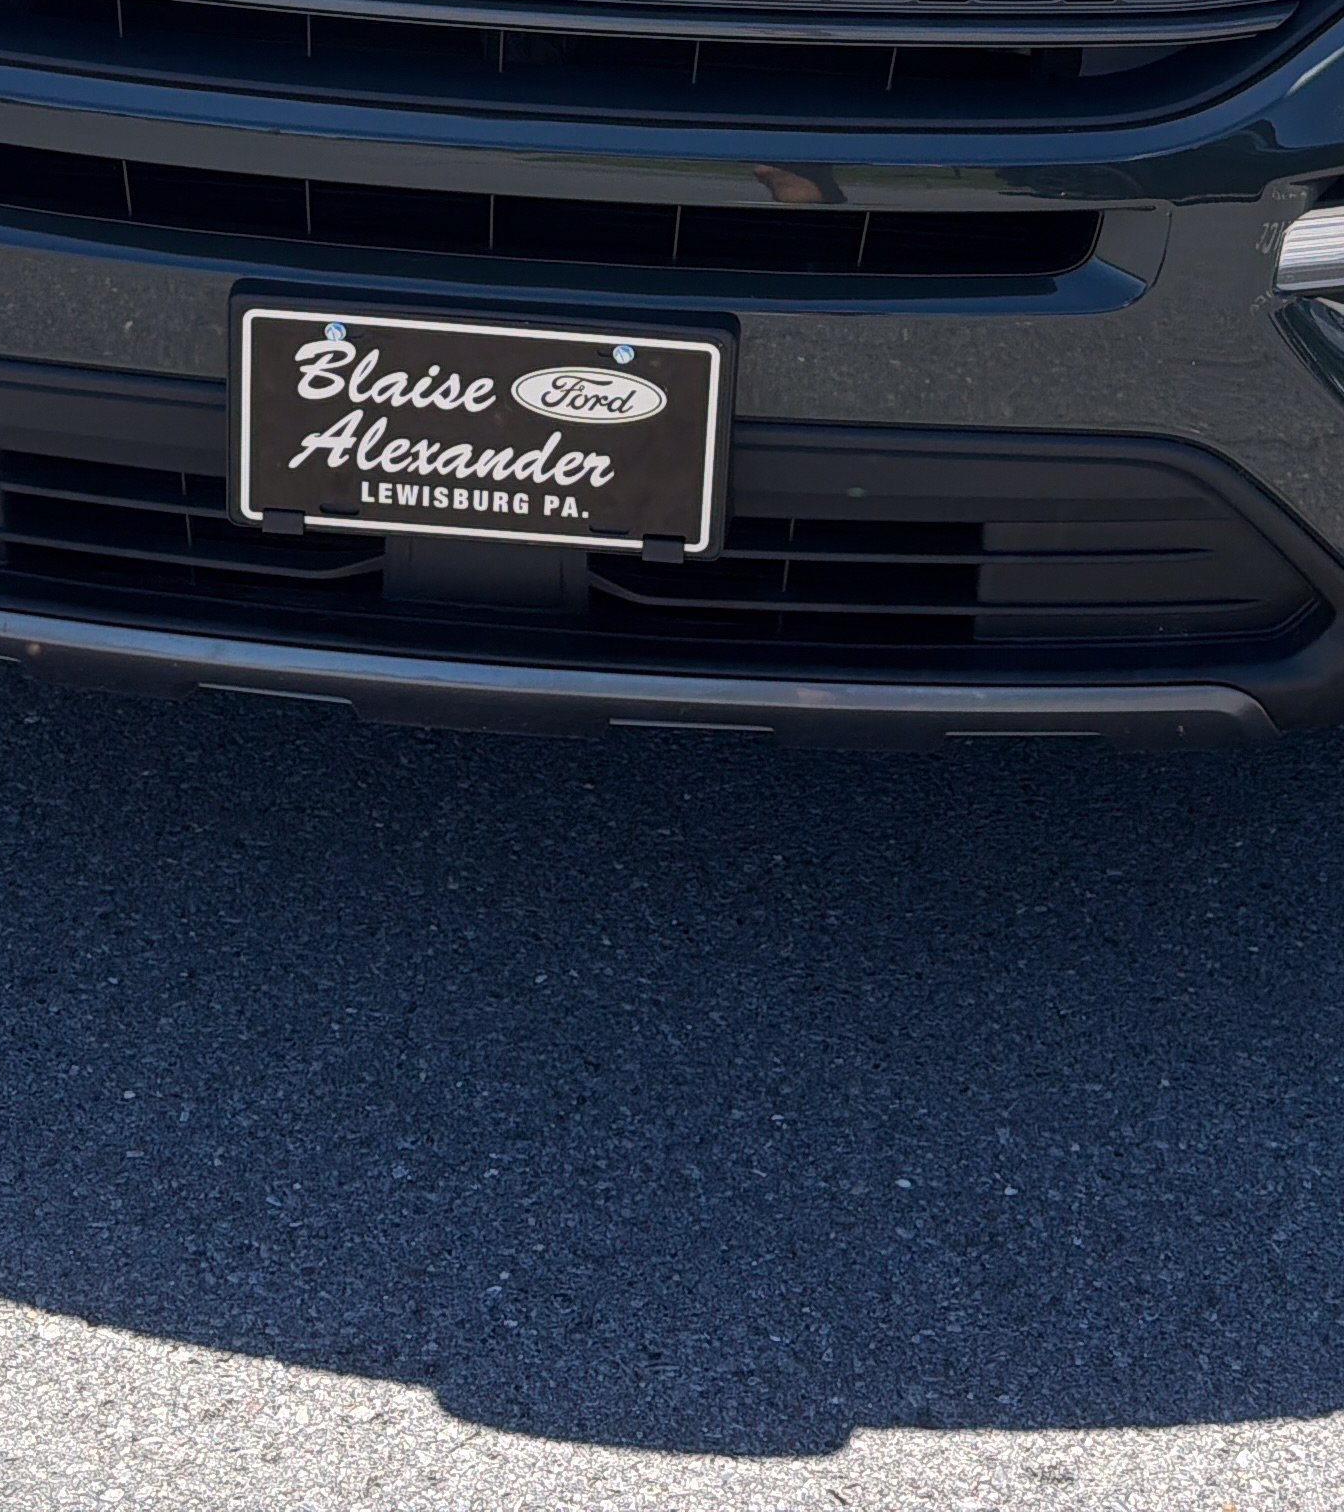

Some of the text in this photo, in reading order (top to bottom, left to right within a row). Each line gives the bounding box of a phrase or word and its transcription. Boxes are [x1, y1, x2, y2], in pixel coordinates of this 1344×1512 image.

[294, 339, 641, 416] Blaise Ford
[288, 408, 616, 488] Alexander
[360, 481, 591, 520] LEWISBURG PA.
